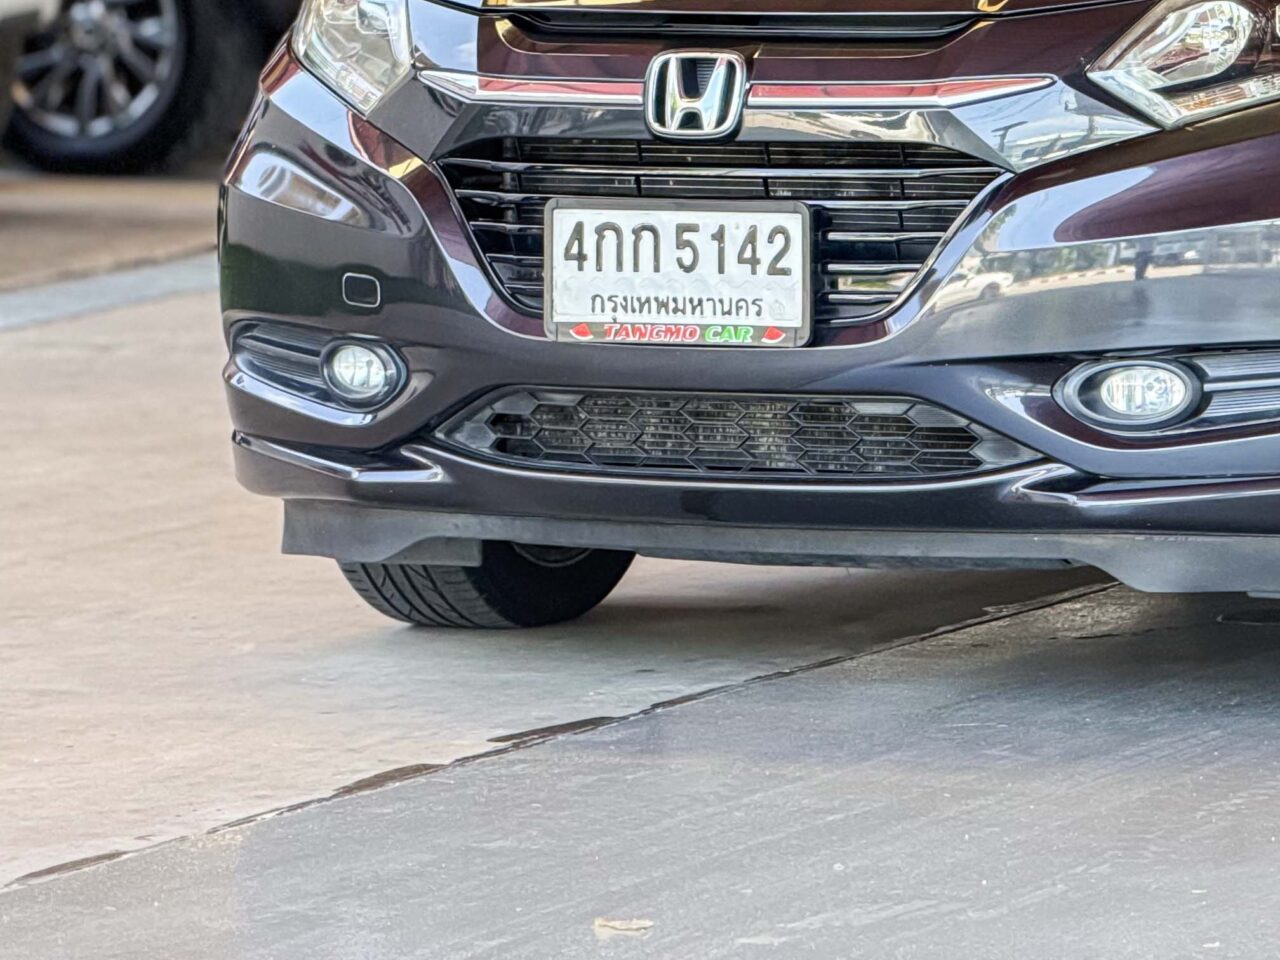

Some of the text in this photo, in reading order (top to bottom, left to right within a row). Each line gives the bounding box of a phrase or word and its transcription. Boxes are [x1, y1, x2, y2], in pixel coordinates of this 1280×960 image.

[563, 220, 792, 276] 4กก 5142
[590, 293, 764, 322] กรุงเทพมหานคร
[603, 322, 754, 343] TANGMO CAR
